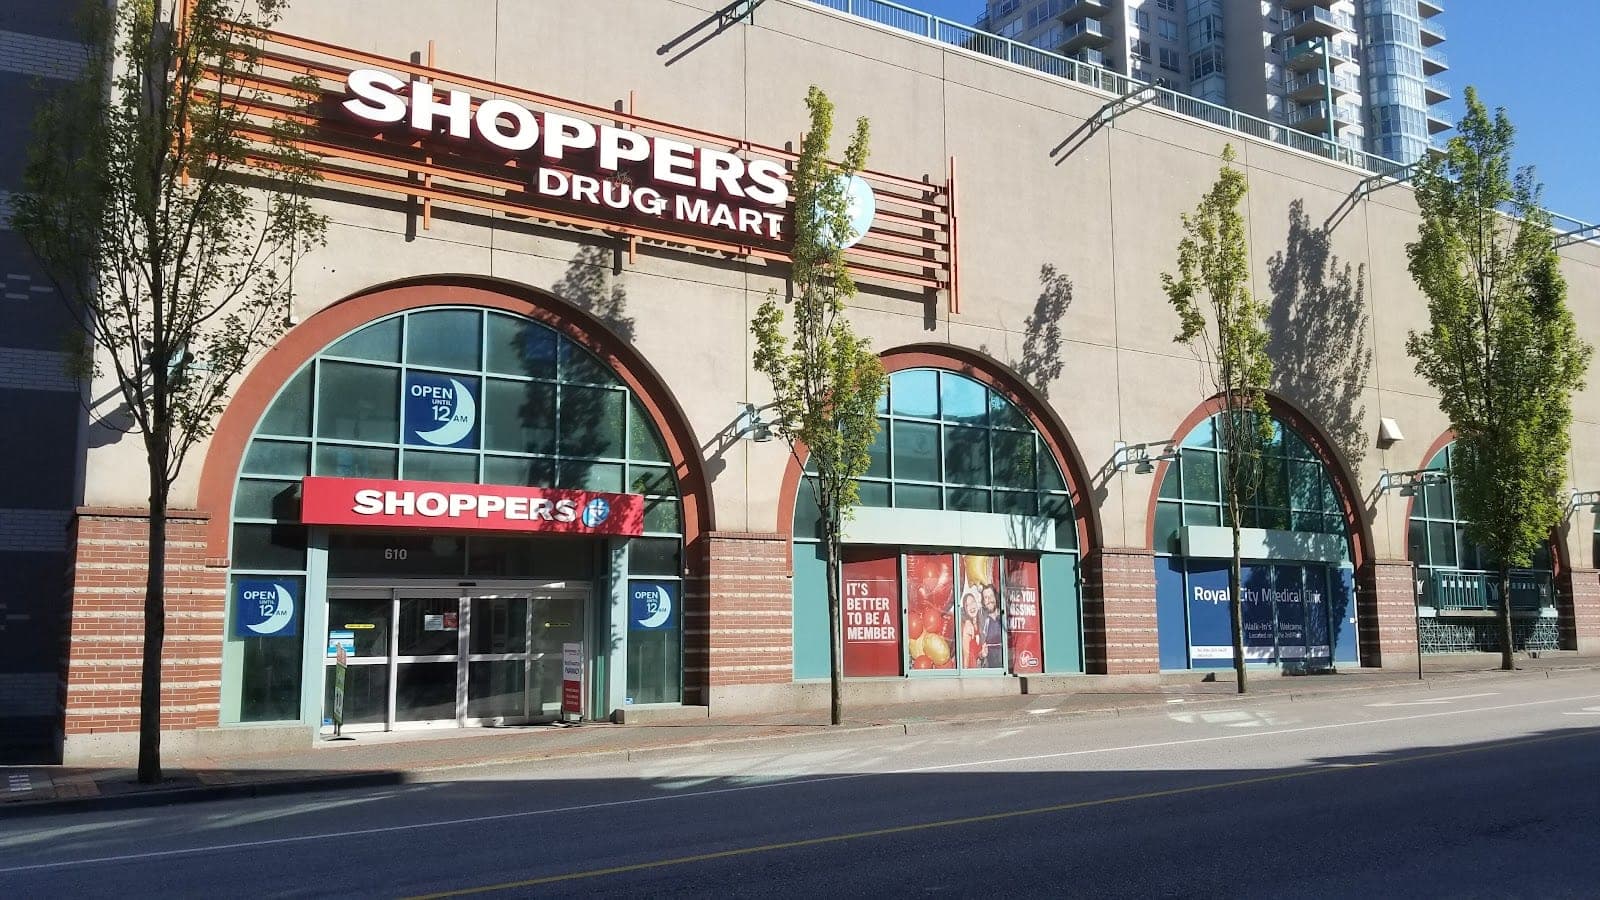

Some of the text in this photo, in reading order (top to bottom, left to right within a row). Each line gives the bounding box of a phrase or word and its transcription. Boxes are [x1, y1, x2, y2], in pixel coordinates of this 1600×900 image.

[342, 68, 790, 205] SHOPPERS
[538, 166, 784, 239] DRUG MART
[411, 384, 453, 399] OPEN
[432, 405, 468, 423] 12 AM
[352, 489, 577, 522] SHOPPERS
[384, 548, 408, 560] 610
[243, 591, 276, 600] OPEN
[635, 591, 659, 600] OPEN
[846, 582, 869, 596] IT'S
[1021, 590, 1036, 602] YOU
[1194, 586, 1231, 605] Royal
[1261, 587, 1302, 602] Medical
[259, 604, 274, 617] 12
[647, 603, 658, 613] 12
[847, 597, 890, 611] BETTER
[847, 611, 891, 625] TO BE A
[847, 626, 896, 640] MEMBER
[1243, 622, 1272, 631] Walk-In's
